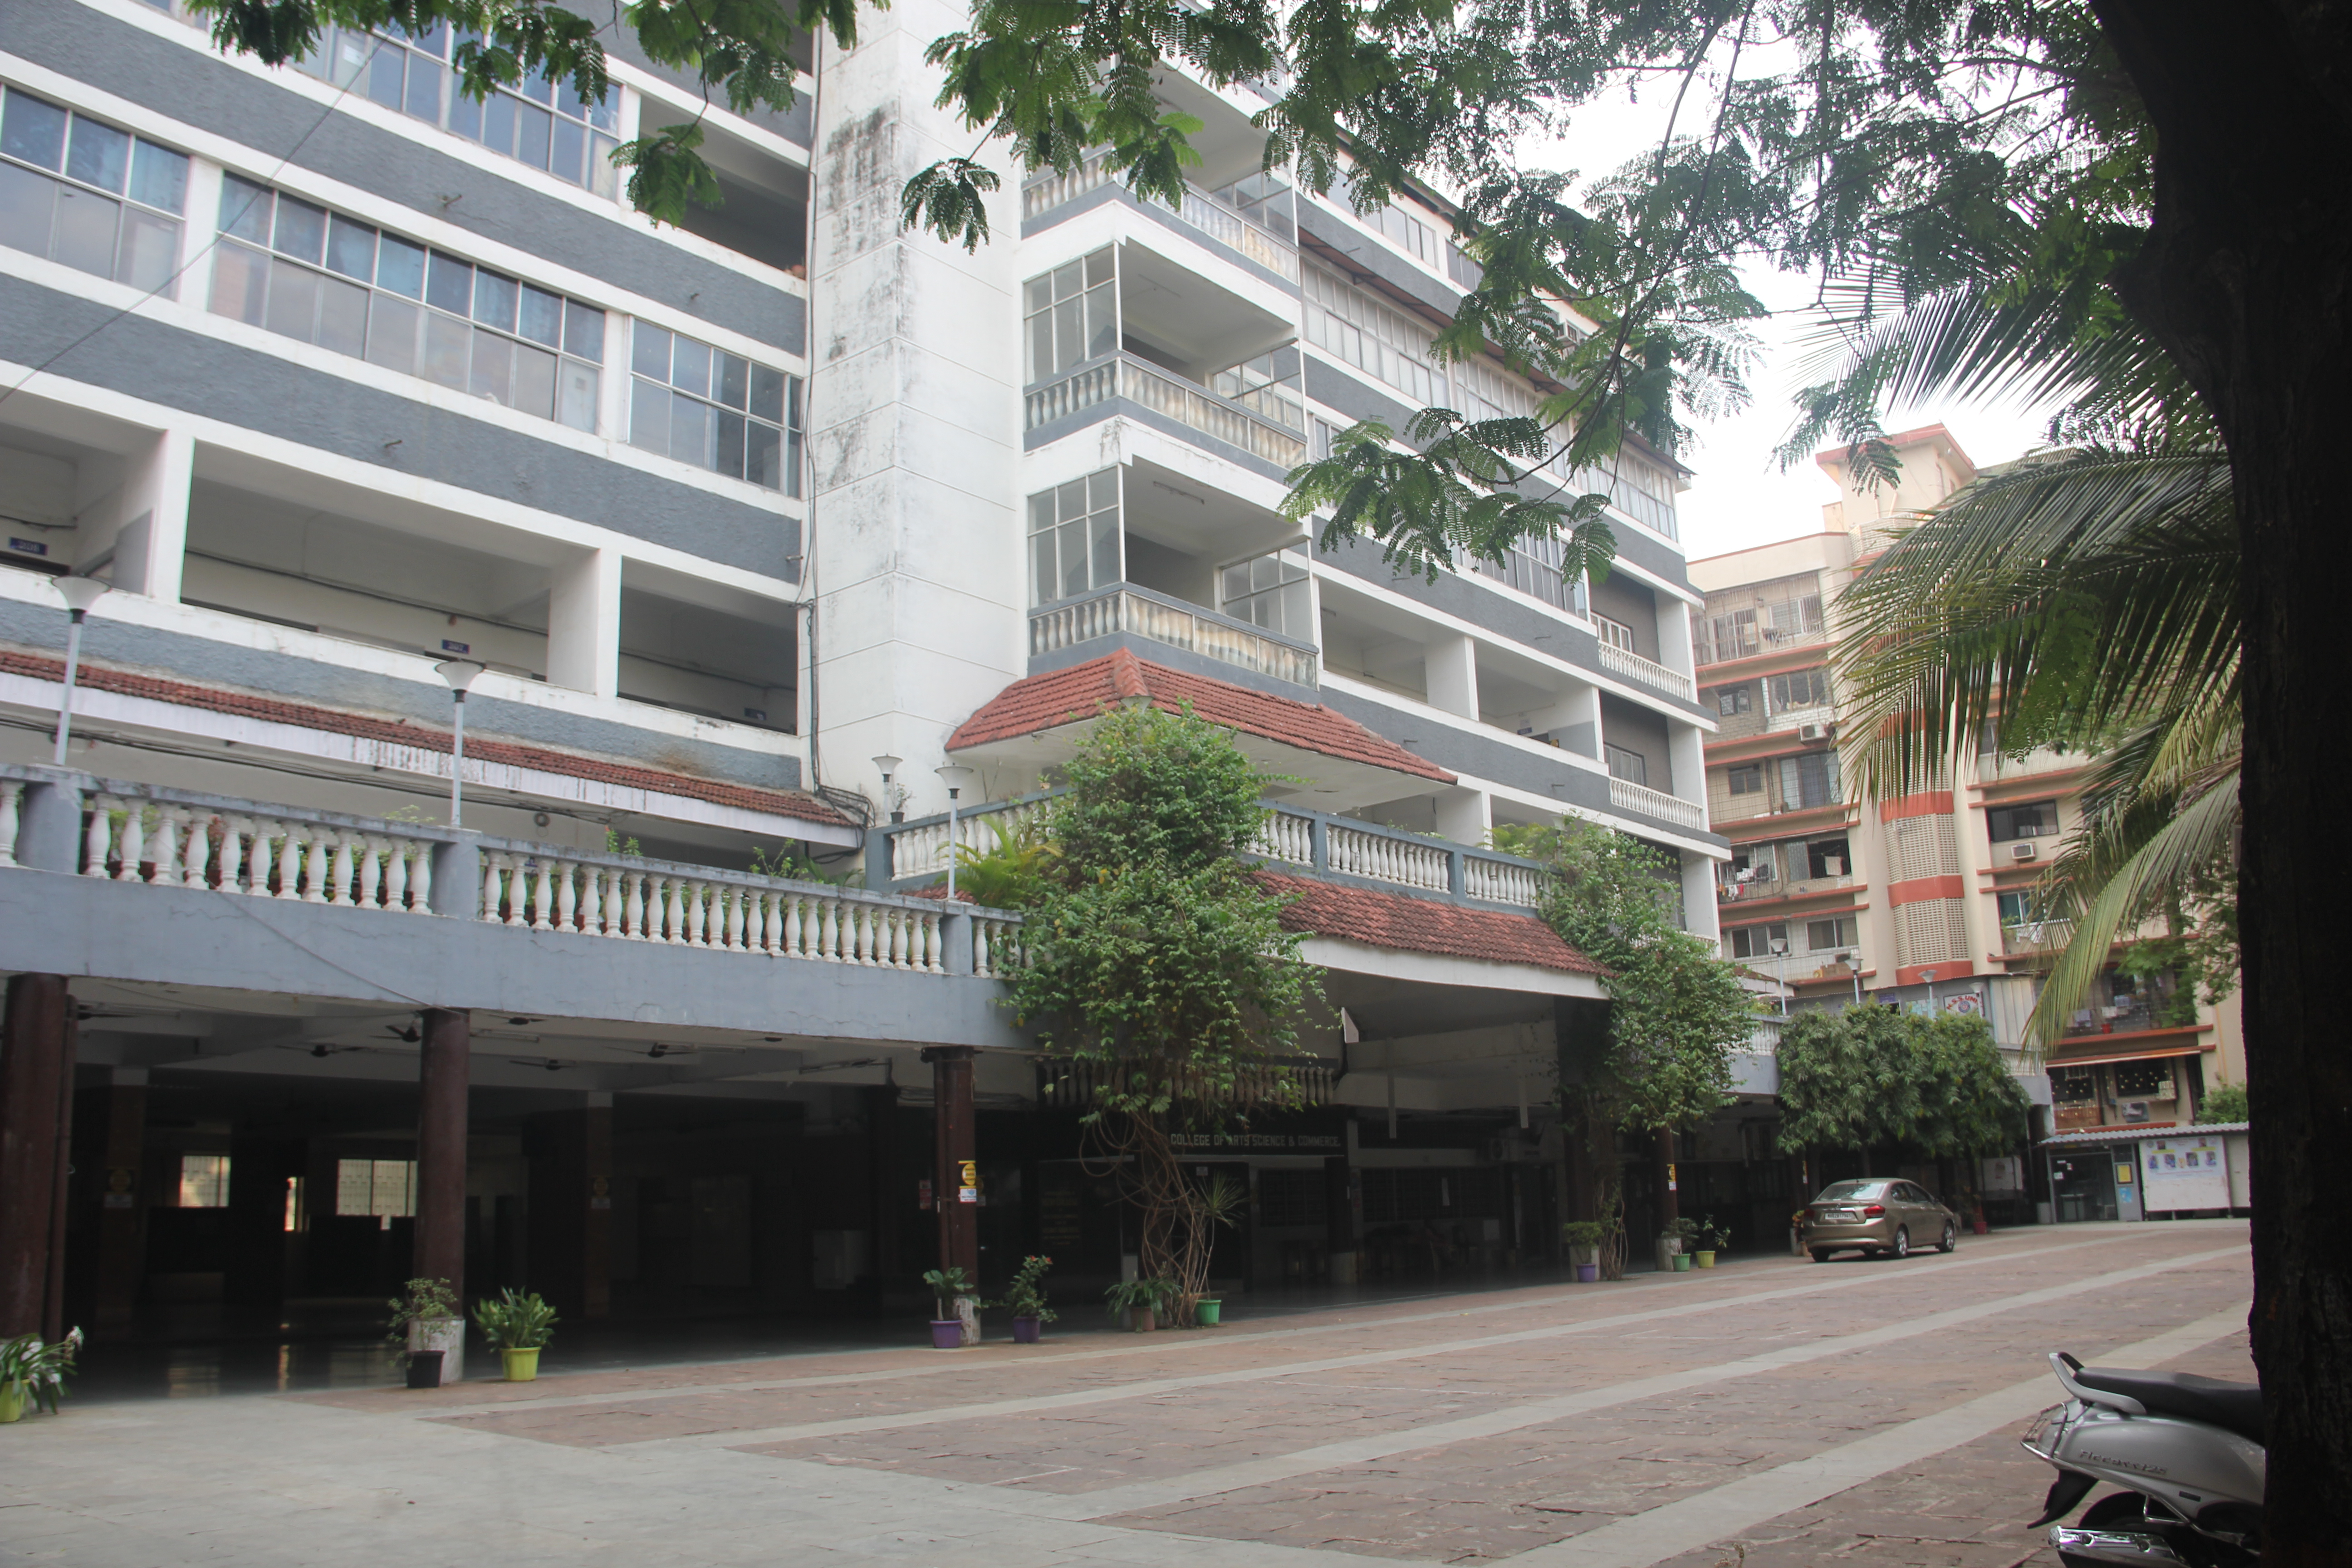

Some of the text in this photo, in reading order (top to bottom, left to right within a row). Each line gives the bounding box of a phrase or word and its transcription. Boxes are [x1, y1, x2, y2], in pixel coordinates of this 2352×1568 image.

[1214, 1134, 1224, 1146] OF
[1229, 1135, 1249, 1146] ARTS
[1252, 1135, 1285, 1146] SCIENCE
[1289, 1136, 1294, 1146] &
